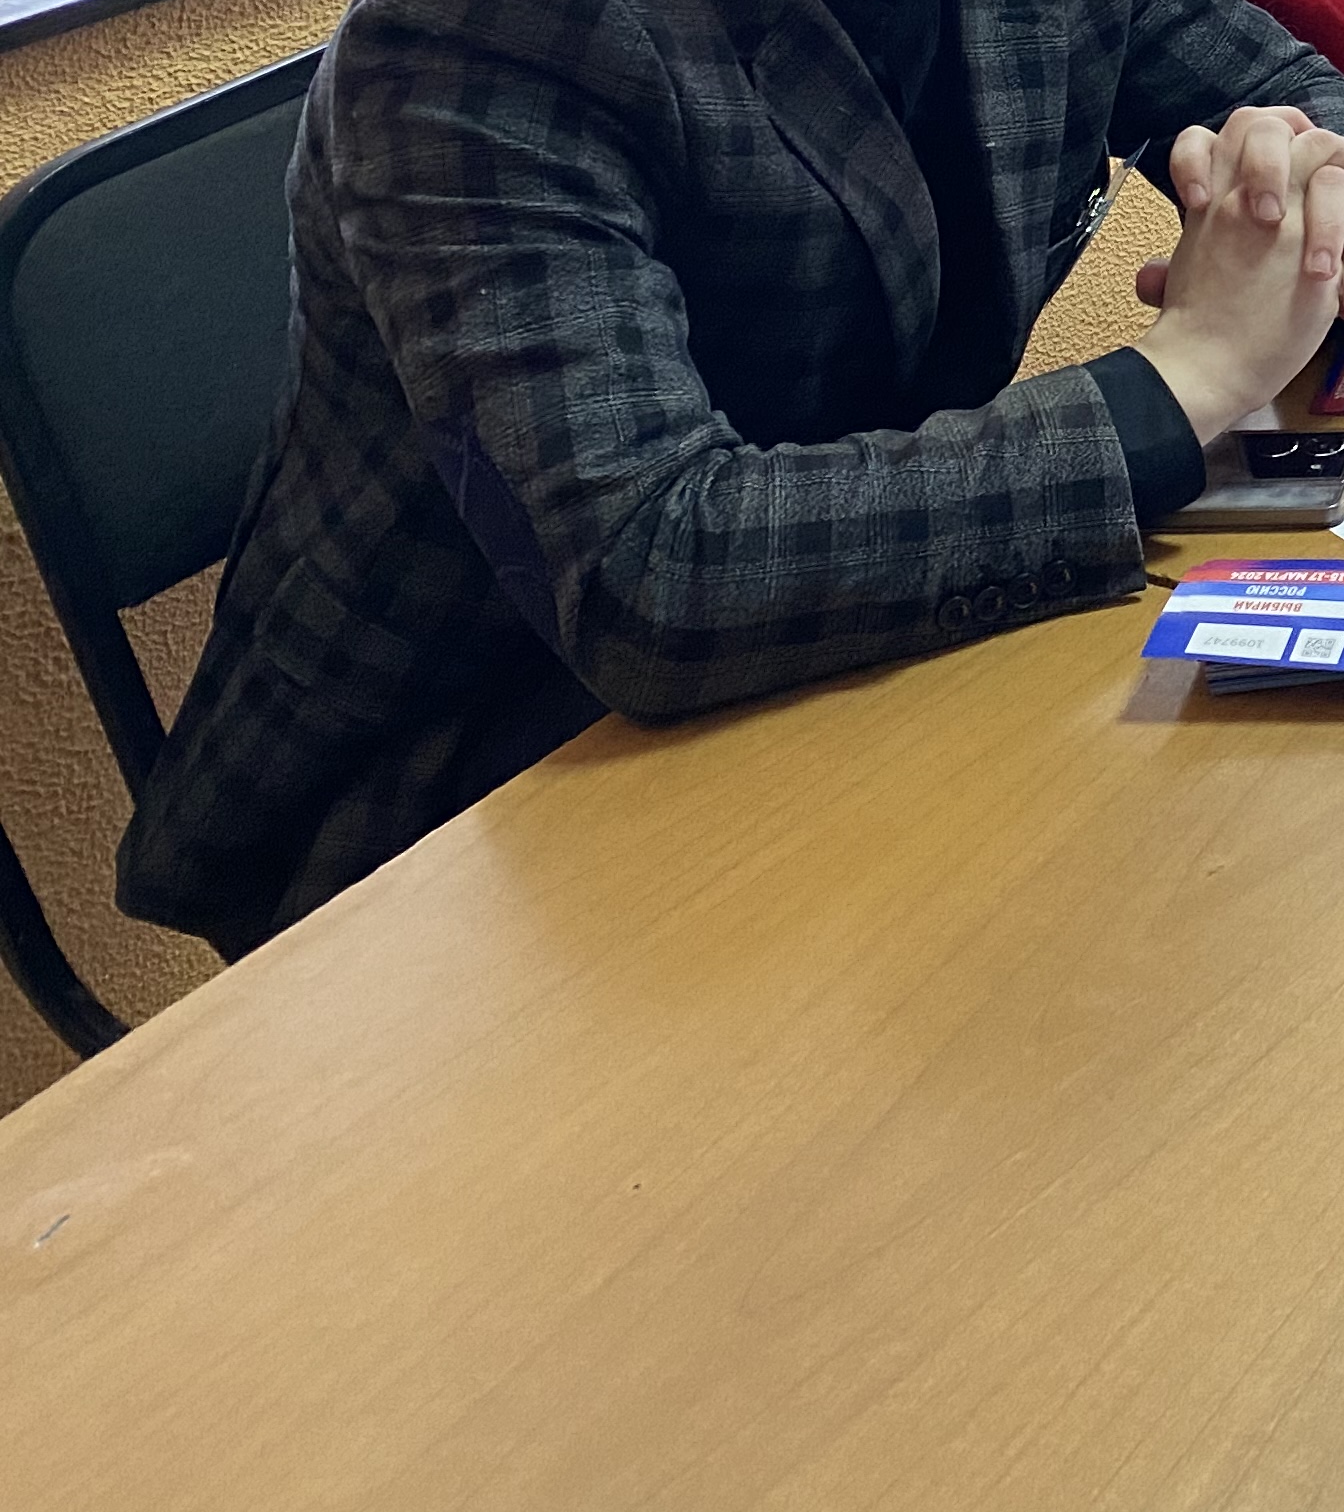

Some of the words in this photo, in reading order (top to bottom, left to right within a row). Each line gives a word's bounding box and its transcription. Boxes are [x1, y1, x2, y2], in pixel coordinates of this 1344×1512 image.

[1230, 571, 1262, 581] 2024
[1263, 571, 1308, 581] МАРТА
[1245, 585, 1307, 596] РОССИЮ
[1232, 600, 1303, 613] ВЫБИРАЙ
[1203, 636, 1264, 649] 1099747
